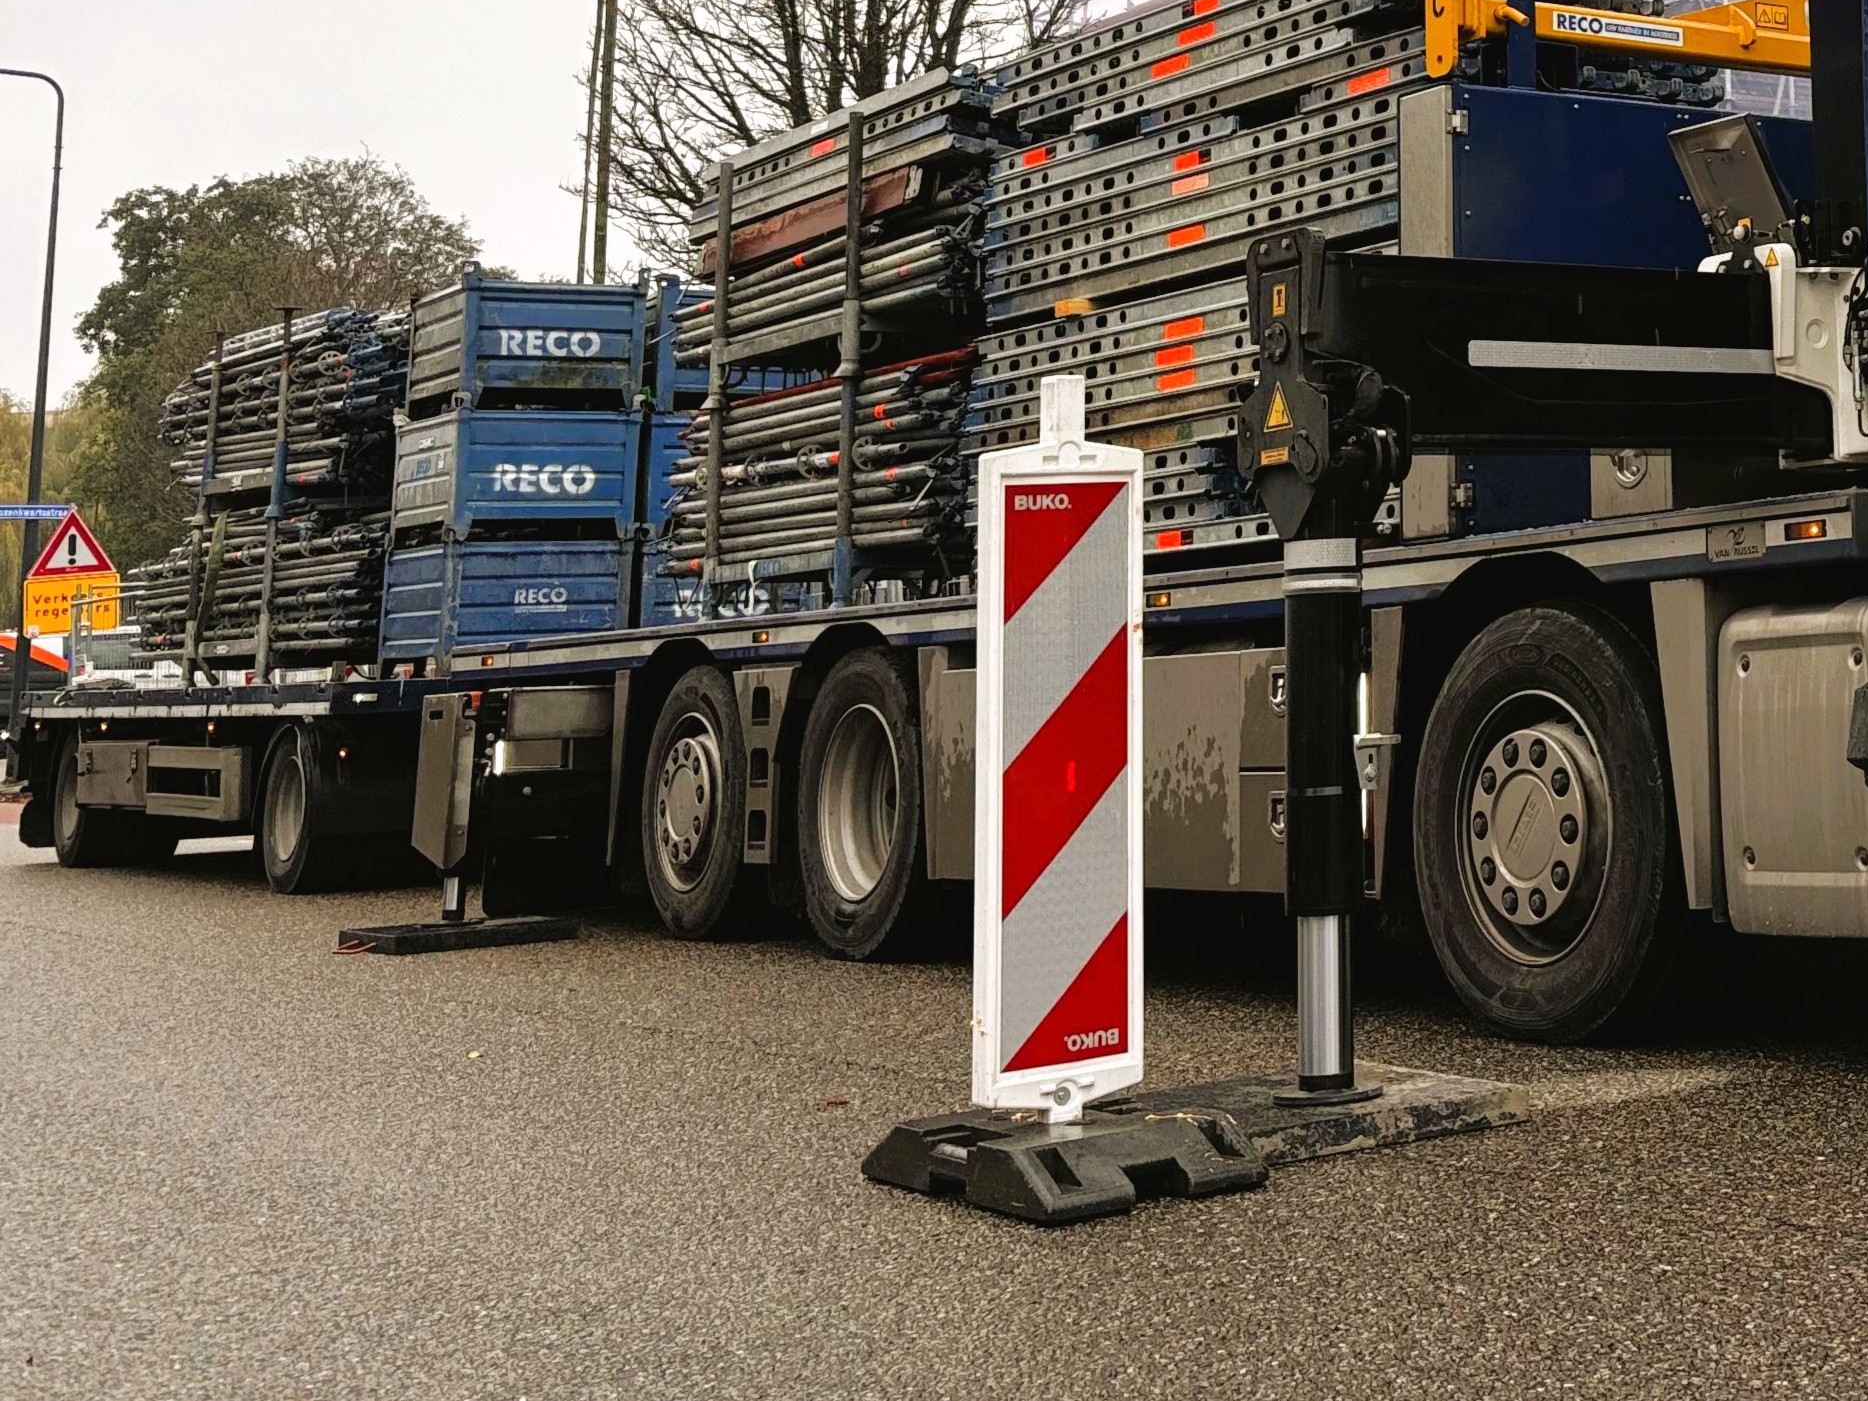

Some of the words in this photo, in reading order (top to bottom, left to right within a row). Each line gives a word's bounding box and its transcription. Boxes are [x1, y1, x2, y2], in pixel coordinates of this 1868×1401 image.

[1556, 13, 1604, 34] RECO
[498, 329, 601, 358] RECO
[494, 463, 596, 495] RECO
[1014, 493, 1073, 511] BUKO.
[514, 587, 568, 605] RECO
[1063, 1027, 1120, 1052] BUKO.
